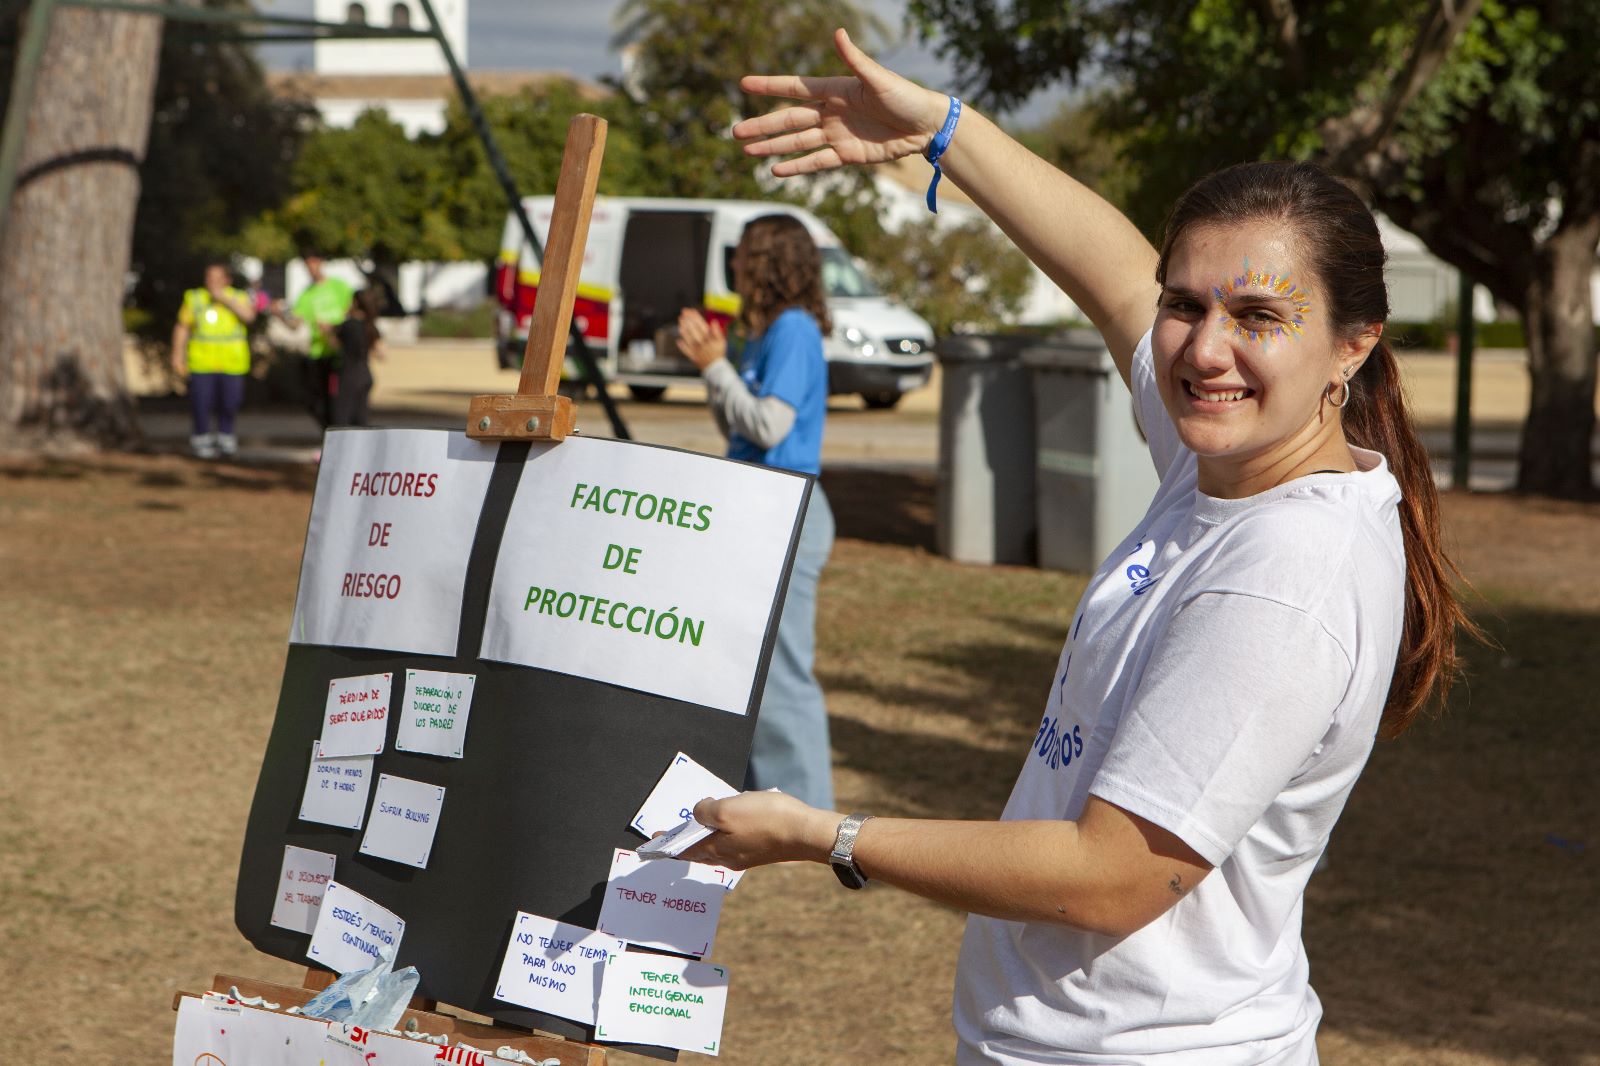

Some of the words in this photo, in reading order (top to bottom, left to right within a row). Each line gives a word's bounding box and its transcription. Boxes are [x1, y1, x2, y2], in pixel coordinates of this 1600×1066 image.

[350, 472, 438, 497] FACTORES
[570, 483, 712, 531] FACTORES
[368, 522, 392, 547] DE
[602, 543, 642, 574] DE
[341, 573, 401, 599] RIESGO
[524, 586, 704, 646] PROTECCIÓN
[371, 688, 379, 700] DE
[329, 711, 348, 725] SERES
[350, 706, 386, 722] QUERIDOS
[413, 701, 441, 713] DIVORCIO
[448, 703, 457, 715] DE
[415, 718, 426, 728] LOS
[429, 717, 454, 730] PADRES
[616, 887, 657, 905] TENER
[663, 897, 707, 913] HOBBIES
[332, 907, 362, 928] ESTRÉS
[342, 932, 380, 958] CONTINUAD
[516, 932, 533, 946] NO
[538, 936, 573, 952] TENER
[579, 945, 608, 961] TIEMP
[522, 953, 546, 969] PARA
[552, 963, 576, 976] UNO
[528, 973, 567, 993] MISMO
[640, 971, 680, 985] TENER
[629, 986, 704, 1004] INTELIGENCIA
[629, 1002, 692, 1019] EMOCIONAL
